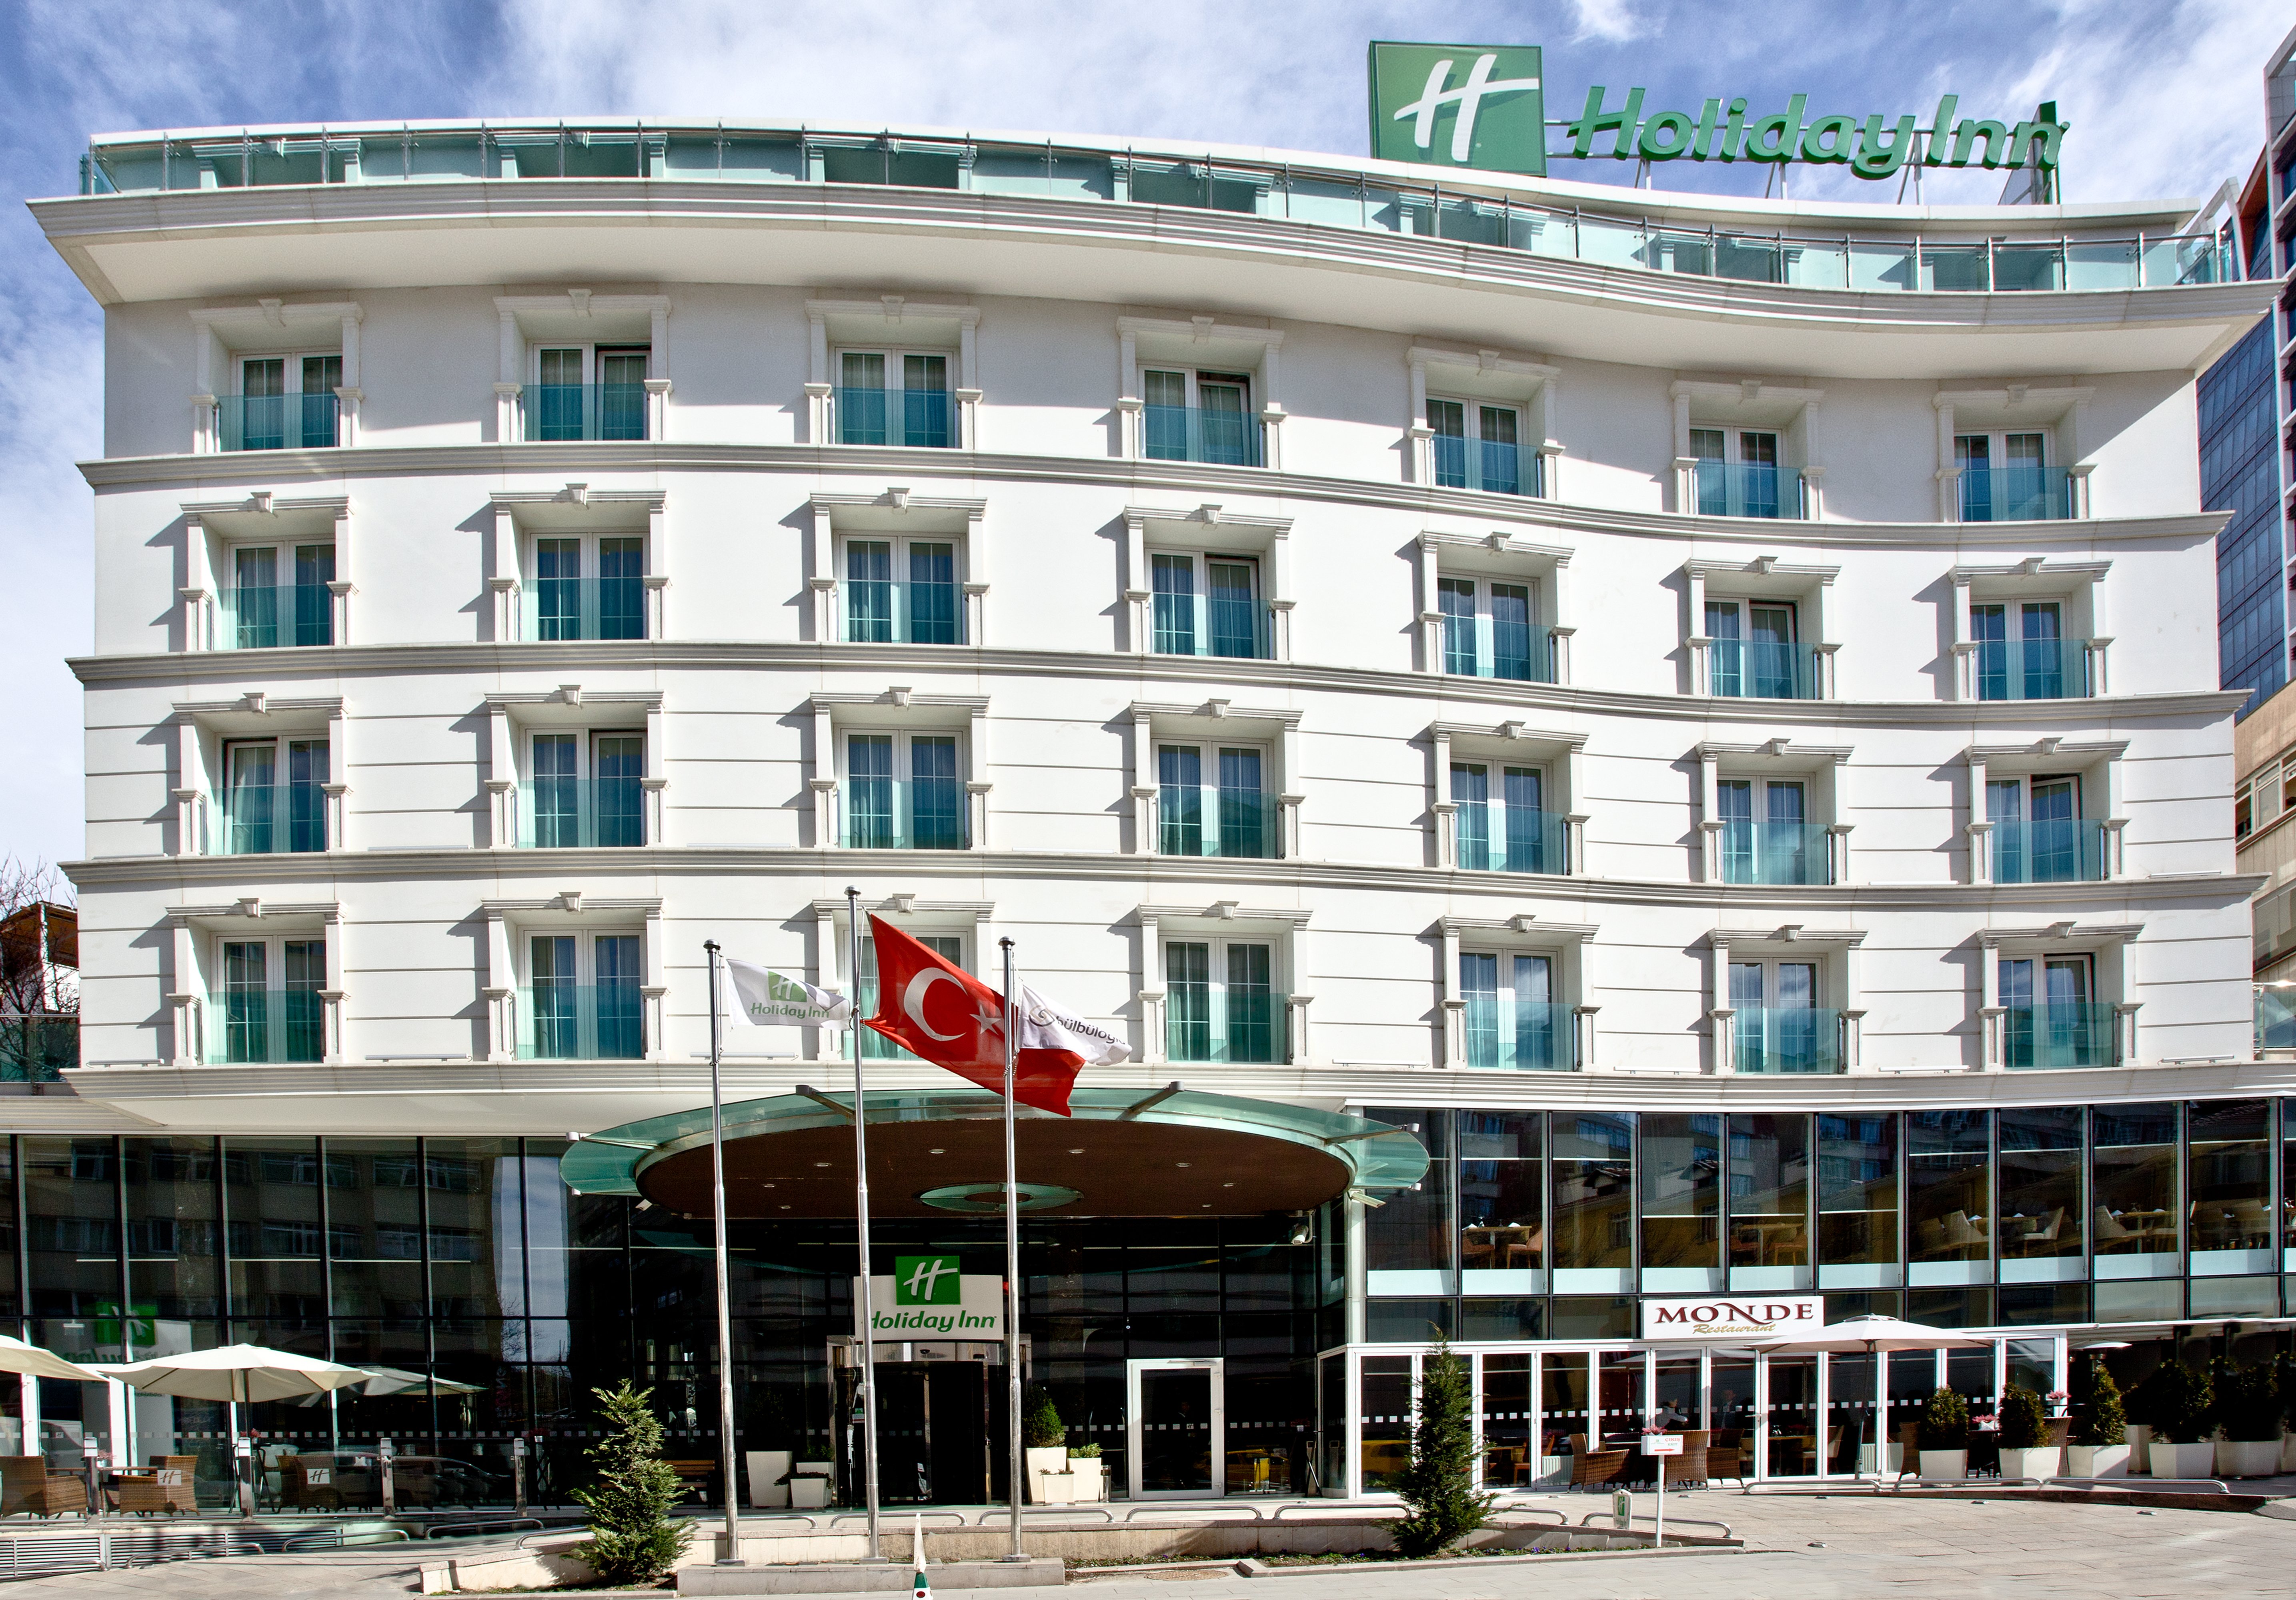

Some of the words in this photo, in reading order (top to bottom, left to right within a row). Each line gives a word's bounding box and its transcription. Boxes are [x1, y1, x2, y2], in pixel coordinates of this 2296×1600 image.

[1567, 86, 1916, 180] Holiday
[1925, 95, 2063, 172] Inn
[751, 1002, 806, 1019] Holiday
[808, 1006, 830, 1018] Inn
[1056, 1016, 1125, 1045] bülbülo
[959, 1310, 995, 1328] Inn
[1653, 1302, 1814, 1325] MONDE
[1692, 1323, 1777, 1334] Restaurant
